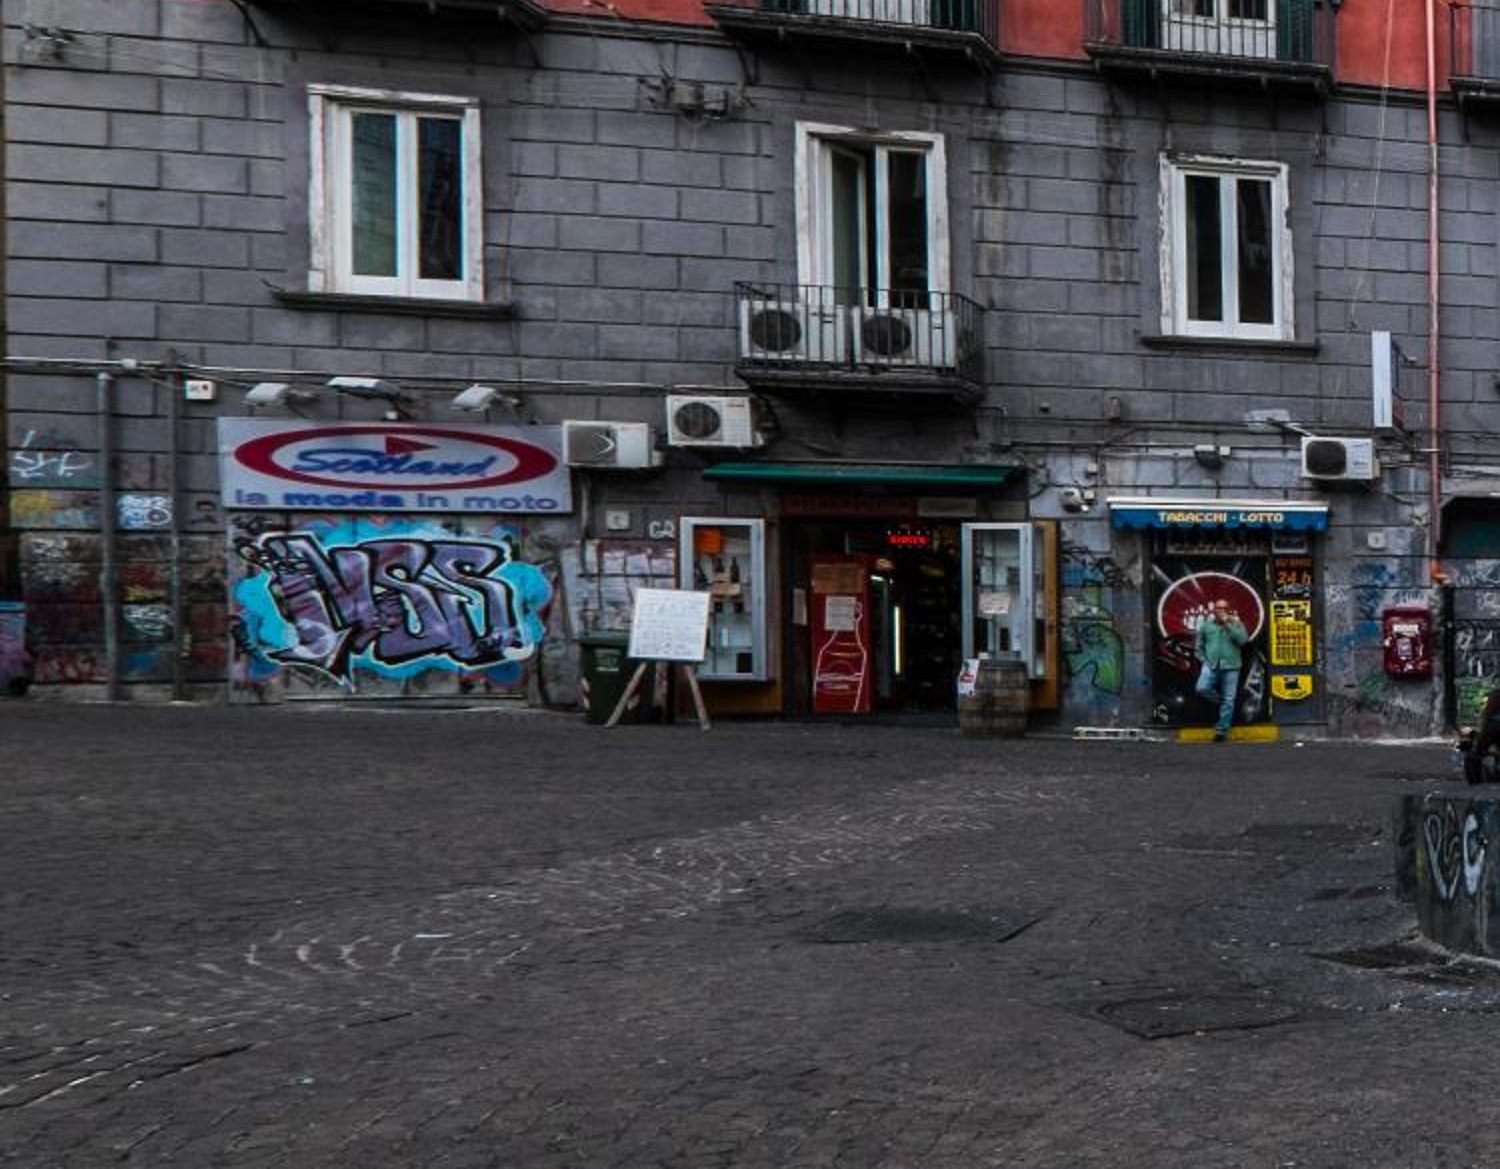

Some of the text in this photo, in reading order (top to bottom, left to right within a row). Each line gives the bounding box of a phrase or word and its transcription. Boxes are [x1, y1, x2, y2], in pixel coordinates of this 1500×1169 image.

[291, 447, 497, 476] Scotland
[234, 489, 558, 511] la moda in moto
[1157, 511, 1227, 523] TABACCHI
[1239, 512, 1284, 523] LOTTO
